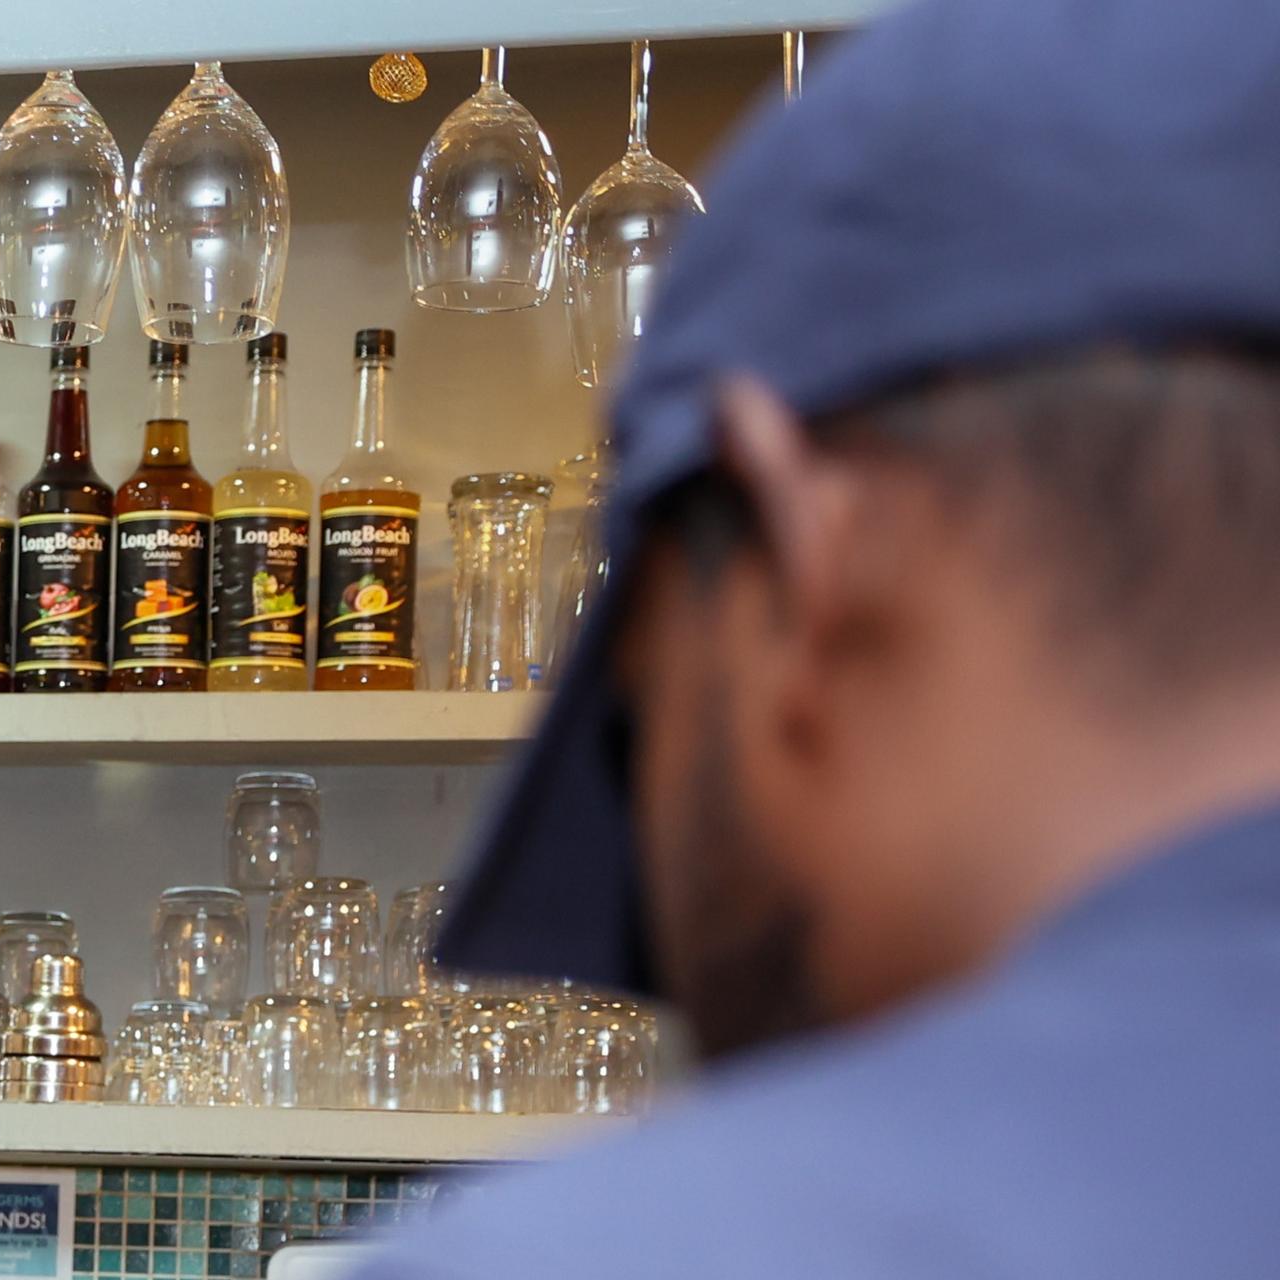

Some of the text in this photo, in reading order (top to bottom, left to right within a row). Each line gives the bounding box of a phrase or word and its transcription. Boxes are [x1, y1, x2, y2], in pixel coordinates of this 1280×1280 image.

[21, 532, 104, 553] LongBeach
[121, 529, 205, 551] LongBeach
[324, 525, 411, 546] LongBeach
[142, 551, 183, 561] CARAMEL
[338, 547, 374, 557] PASSION
